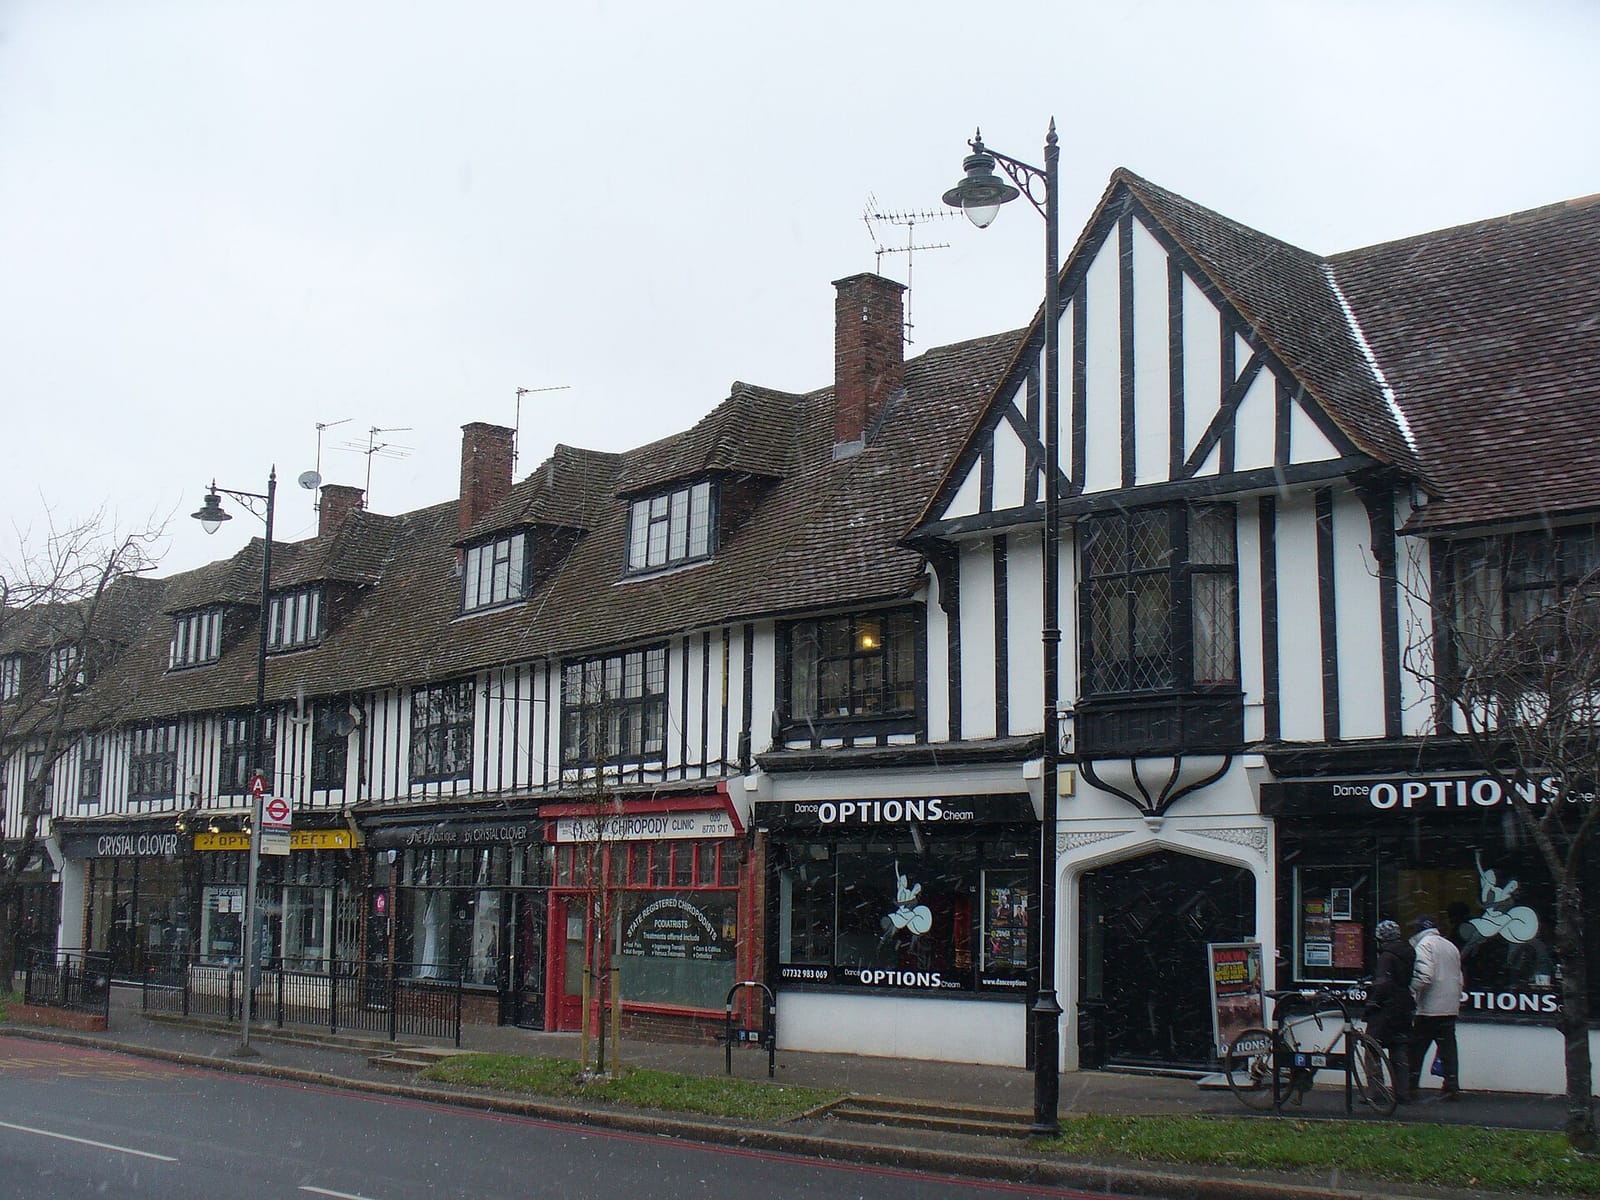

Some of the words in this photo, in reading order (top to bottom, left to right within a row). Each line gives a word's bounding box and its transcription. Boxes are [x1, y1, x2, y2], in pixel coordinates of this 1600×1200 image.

[253, 778, 263, 791] A
[1333, 784, 1369, 797] Dance
[1370, 776, 1562, 809] OPTIONS
[795, 803, 819, 814] Dance
[818, 799, 943, 824] OPTIONS
[943, 810, 974, 821] Cheam
[473, 827, 500, 841] CRYSTAL
[500, 826, 527, 840] CLOVER
[611, 817, 669, 836] CHIROPODY
[671, 818, 695, 831] CLINIC
[97, 834, 136, 856] CRYSTAL
[137, 833, 178, 855] CLOVER
[290, 834, 328, 845] RECT
[626, 913, 643, 938] STATE
[641, 898, 677, 920] REGISTERED
[677, 899, 718, 941] CHIROPODISTS
[654, 919, 689, 929] PODIATRISTS
[782, 968, 801, 978] 07732
[802, 969, 815, 979] 983
[815, 970, 828, 980] 069
[844, 968, 861, 977] Dance
[860, 969, 941, 988] OPTIONS
[941, 980, 961, 989] Cheam
